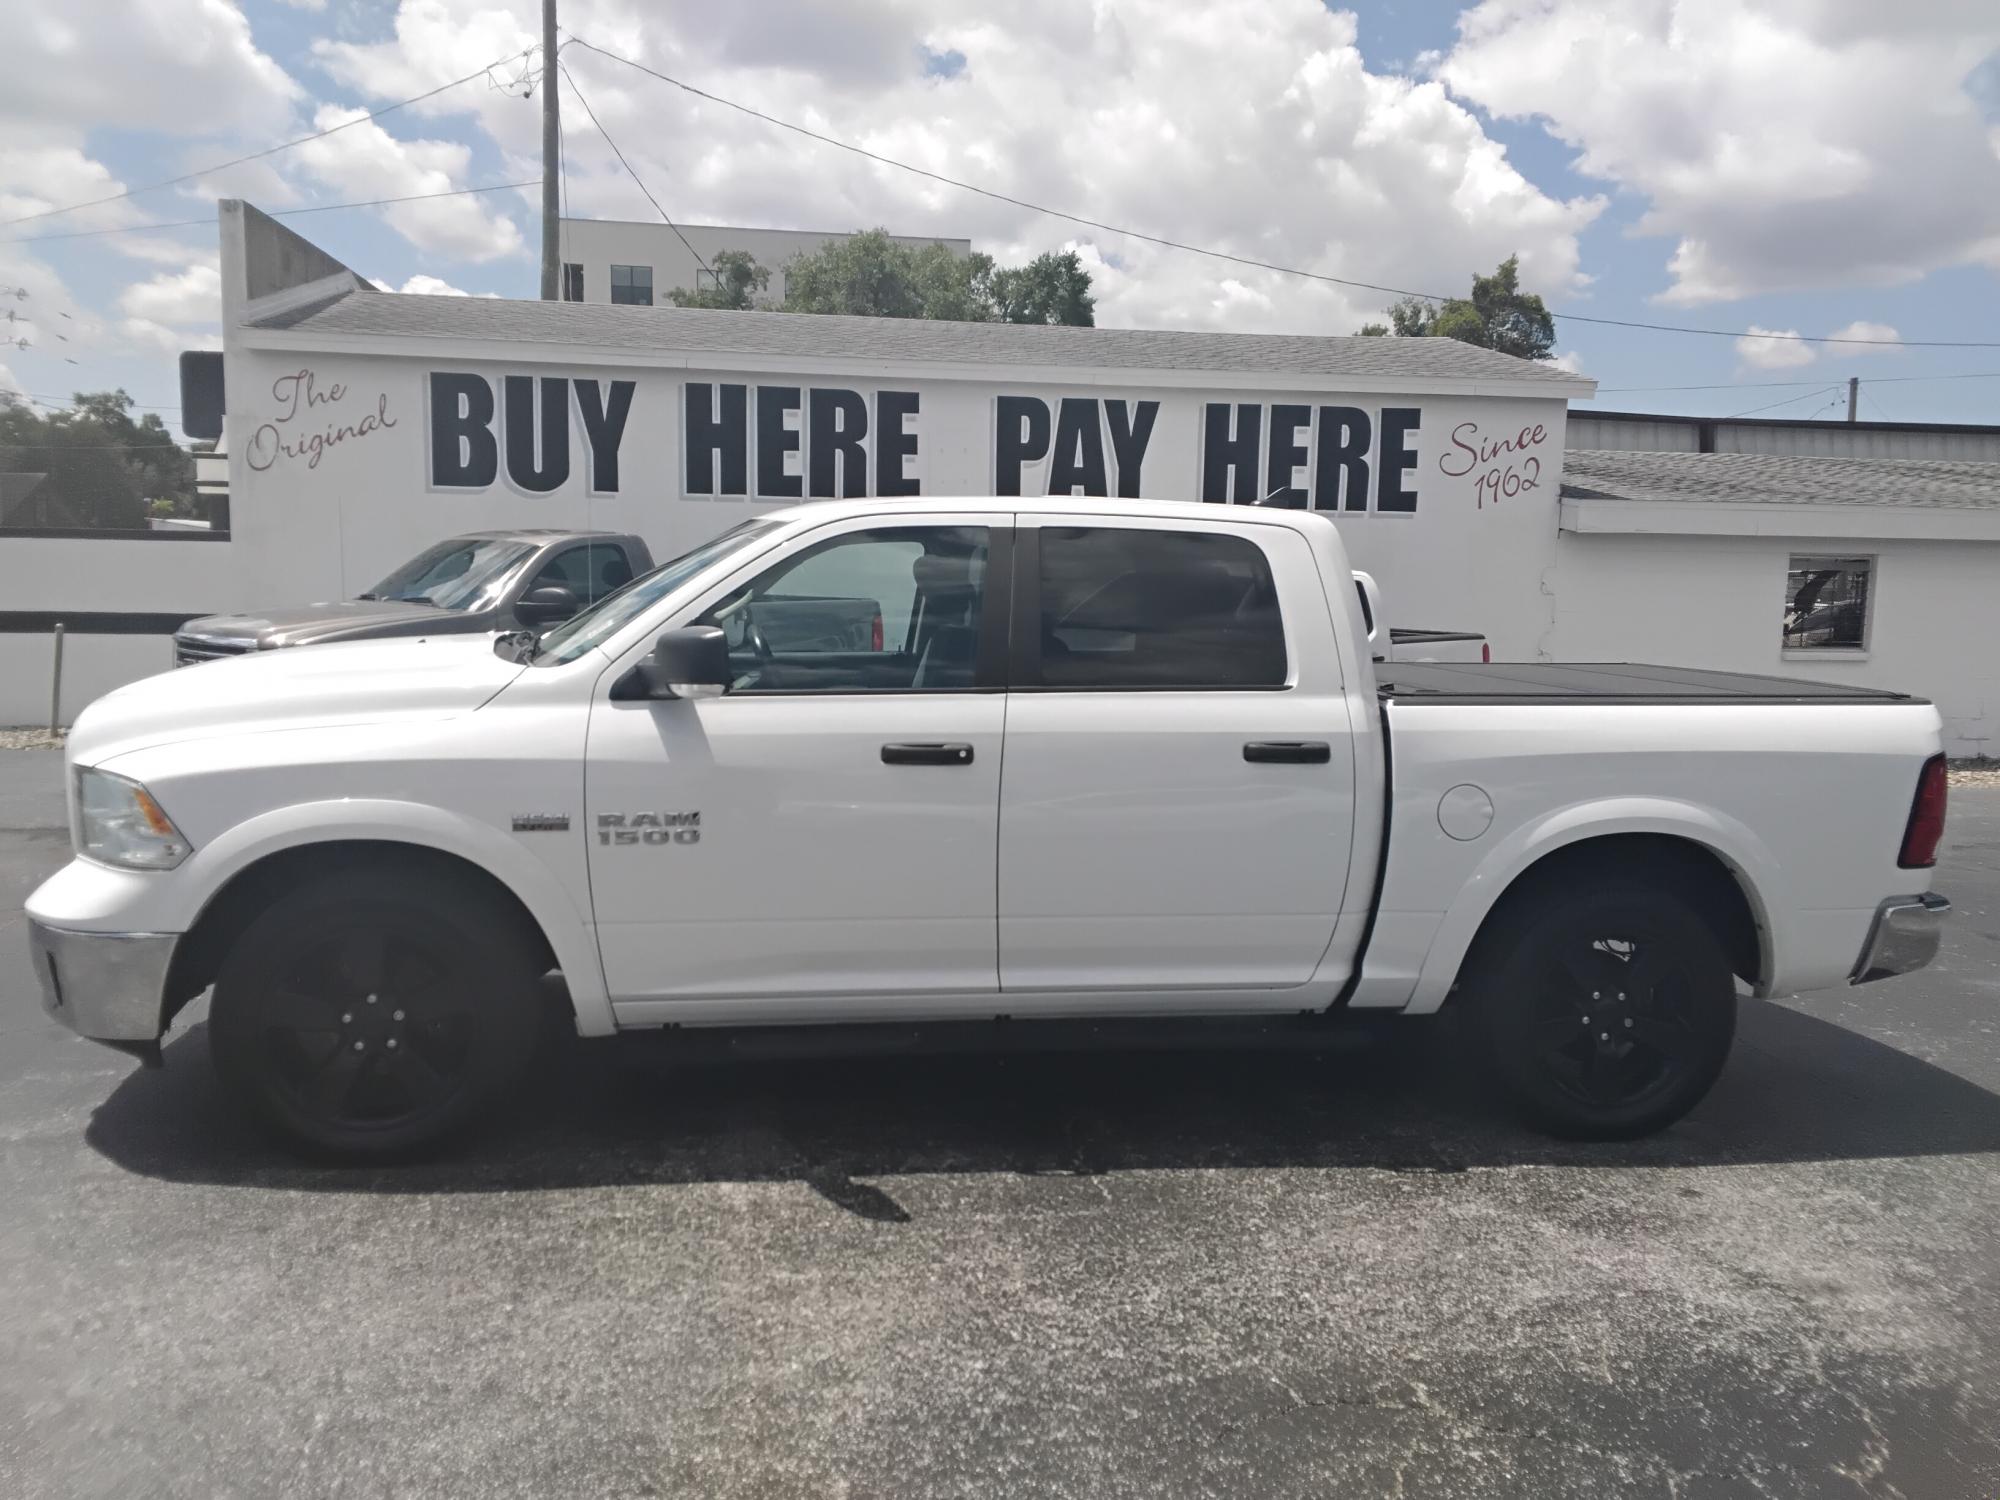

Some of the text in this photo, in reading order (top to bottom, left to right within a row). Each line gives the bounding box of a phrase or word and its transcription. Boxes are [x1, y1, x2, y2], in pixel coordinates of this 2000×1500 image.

[272, 368, 347, 423] The
[246, 393, 397, 472] Original
[429, 370, 1421, 512] BUY HERE PAY HERE
[1439, 422, 1548, 477] Since
[1474, 456, 1541, 510] 1962
[597, 811, 701, 828] RAM
[598, 829, 701, 846] 1500
